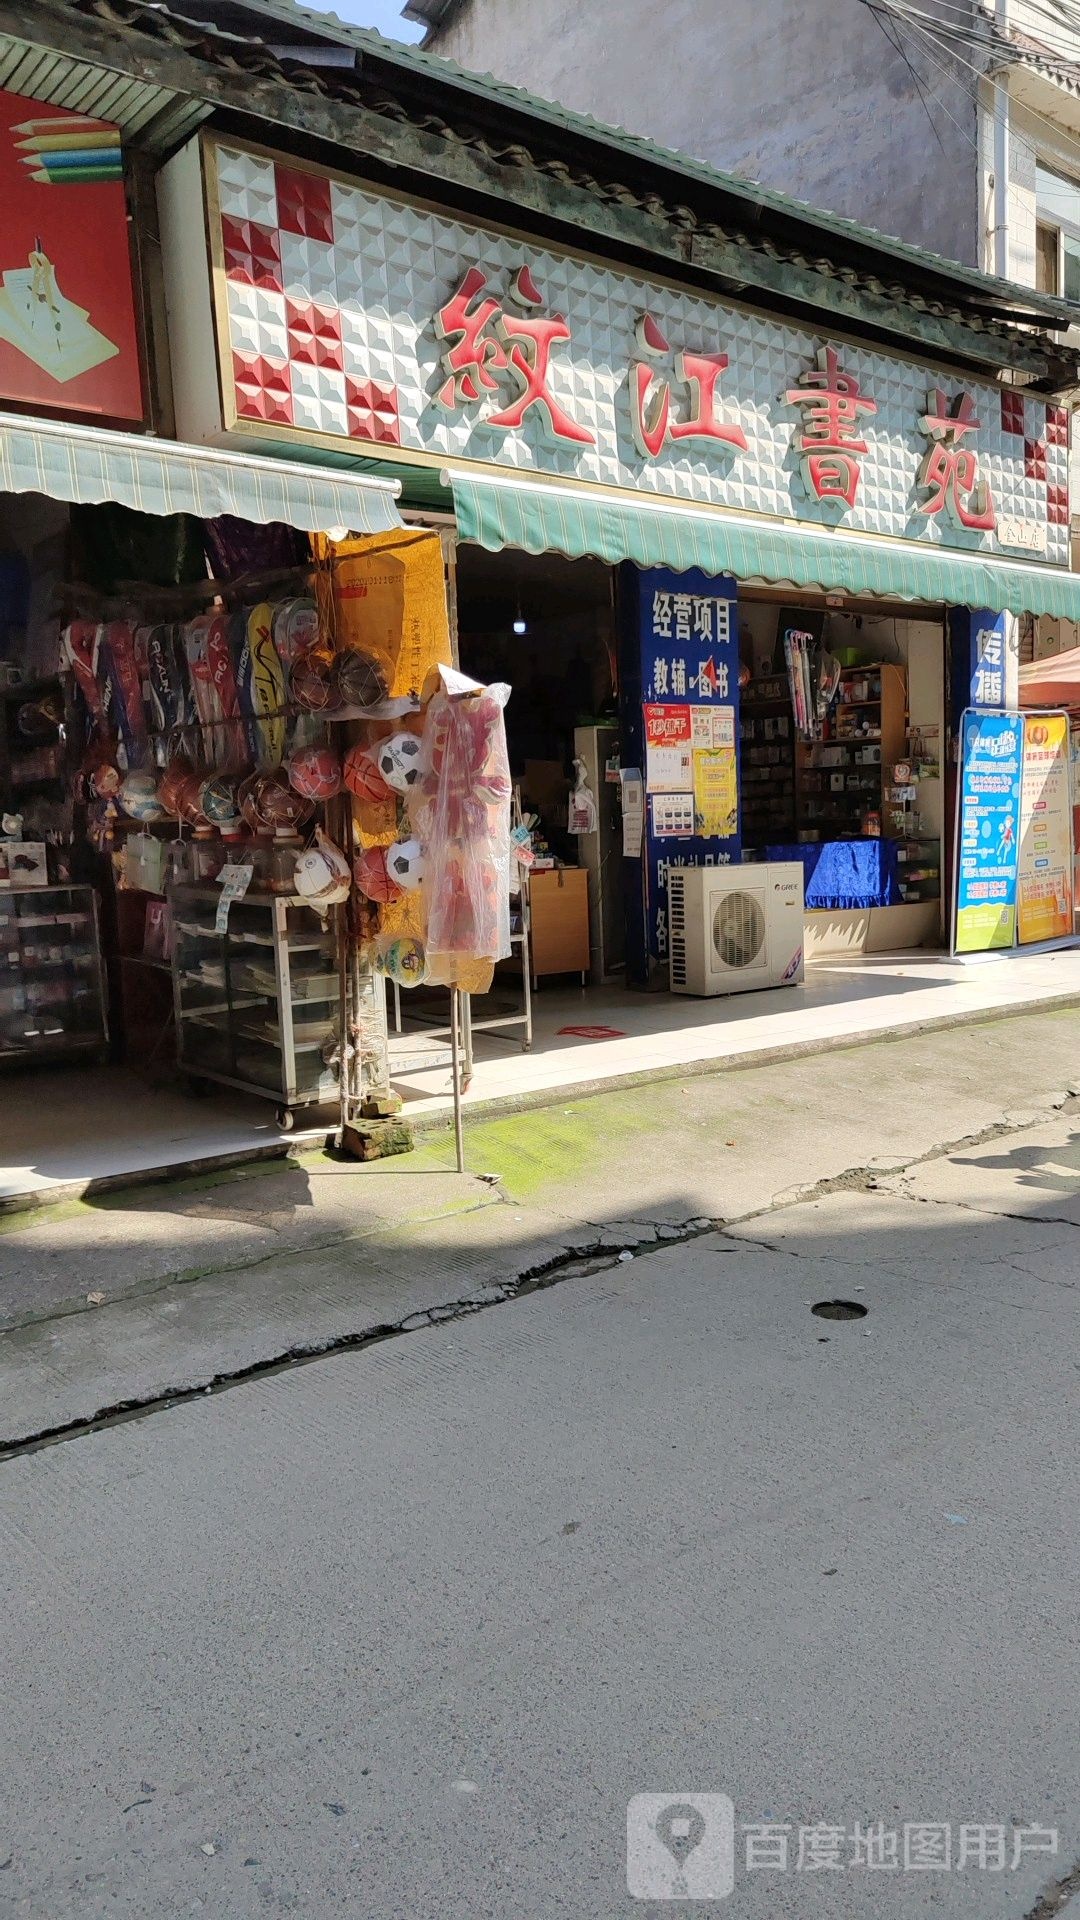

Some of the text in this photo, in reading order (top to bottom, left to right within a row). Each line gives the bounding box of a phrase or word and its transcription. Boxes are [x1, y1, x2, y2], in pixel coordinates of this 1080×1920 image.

[435, 264, 996, 532] 紋江書苑
[652, 590, 730, 644] 经营项目
[974, 628, 1002, 717] 传播
[781, 883, 799, 892] GREE
